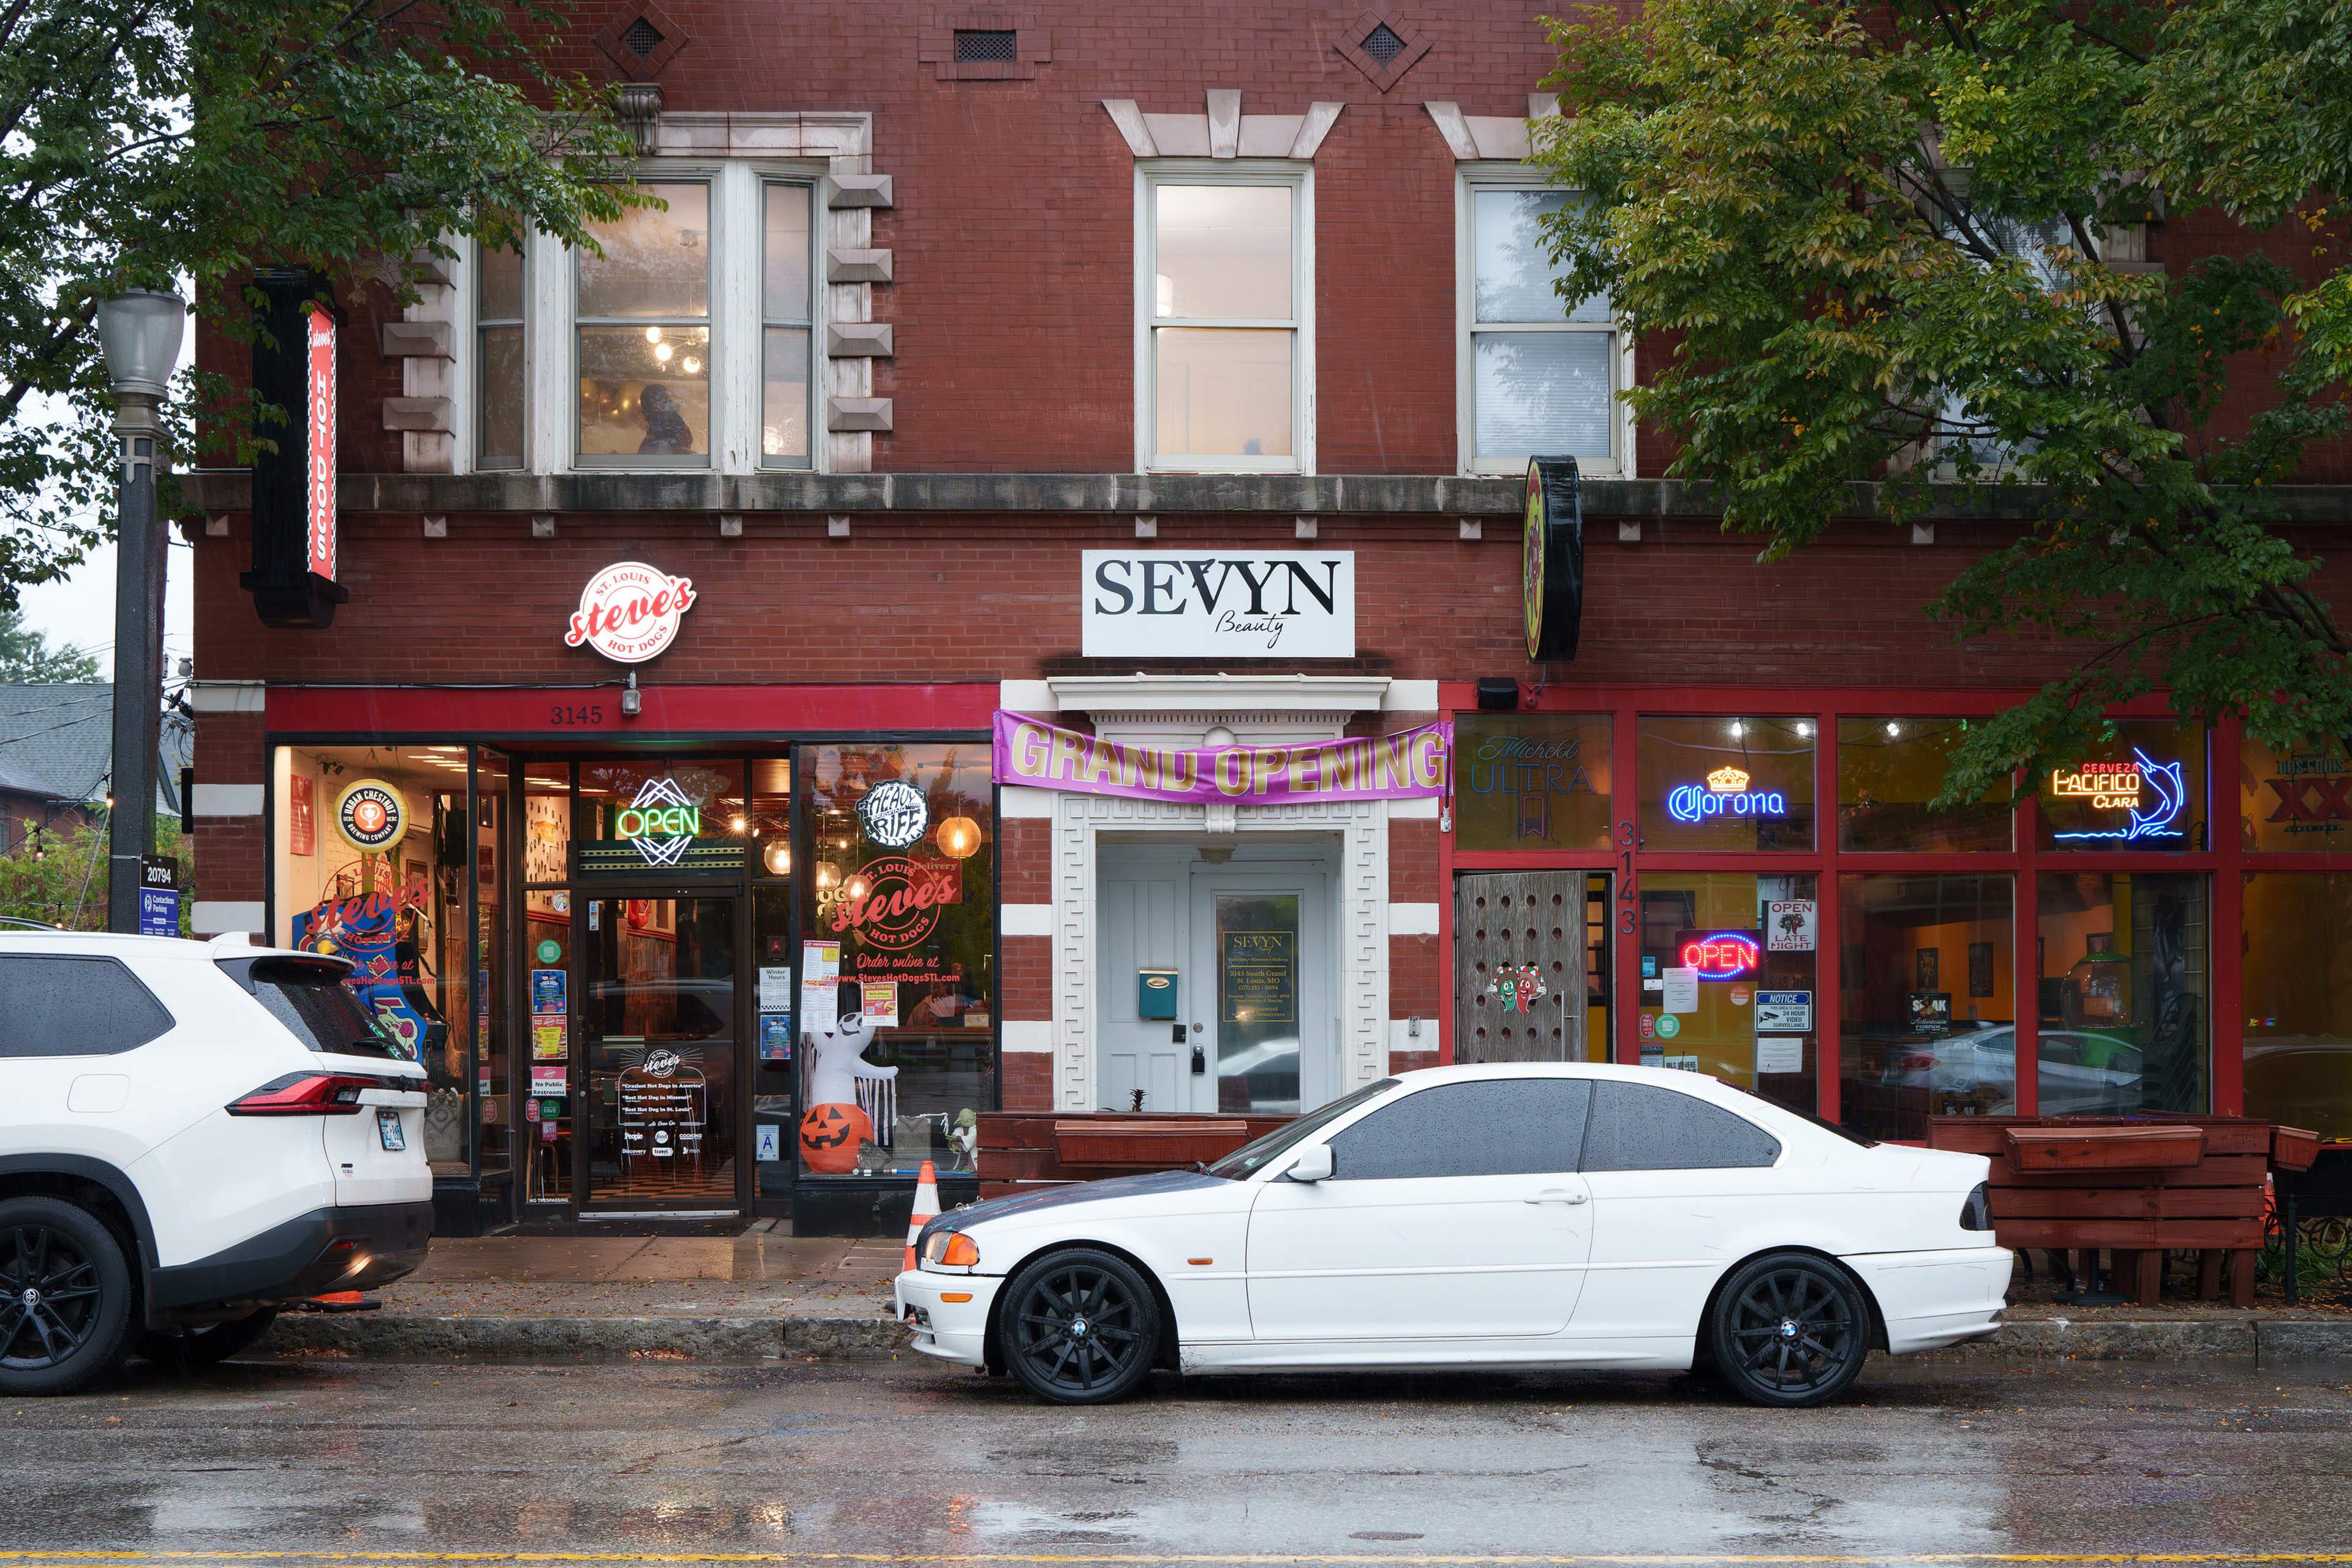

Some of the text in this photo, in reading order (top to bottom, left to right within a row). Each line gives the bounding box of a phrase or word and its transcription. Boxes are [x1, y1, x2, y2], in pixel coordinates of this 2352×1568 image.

[312, 328, 331, 348] steve's
[317, 369, 327, 562] HOT DOGS
[596, 572, 650, 597] ST. LOUIS
[1095, 558, 1341, 616] SEVYN
[567, 578, 694, 644] steve's
[1214, 609, 1288, 649] Beauty
[608, 625, 667, 654] HOT DOGS
[551, 706, 603, 725] 3145
[1011, 722, 1447, 797] GRAND OPENING
[2082, 763, 2139, 773] CERVEZA
[1471, 763, 1596, 794] ULTRA
[2054, 769, 2139, 795] PACIFICO
[344, 790, 397, 815] URBAN CHESTNUT
[869, 786, 916, 816] HEAVY
[1668, 785, 1784, 822] Corona
[2093, 794, 2139, 809] CLARA
[347, 823, 393, 841] BREWING COMPANY
[617, 807, 699, 837] OPEN
[873, 809, 921, 838] RIFF
[147, 866, 172, 883] 20794
[353, 866, 391, 880] LOUIS
[877, 864, 916, 877] LOUIS
[914, 861, 958, 872] Delivery
[1619, 820, 1636, 935] 3143
[153, 904, 167, 914] Parking
[306, 874, 432, 935] steve's
[831, 872, 957, 932] steve's
[1772, 903, 1812, 913] OPEN
[344, 931, 370, 946] HOT
[869, 916, 930, 943] HOT DOGS
[1234, 935, 1283, 948] SEVYN
[402, 959, 415, 970] at
[857, 952, 889, 968] Order
[892, 952, 924, 968] online
[927, 956, 940, 967] at
[1684, 944, 1755, 968] OPEN
[834, 973, 960, 984] www.StevesHotDogsSTL.com
[1769, 994, 1798, 1003] NOTICE
[642, 1054, 681, 1073] steve's
[624, 1132, 644, 1141] People
[763, 1136, 773, 1150] A
